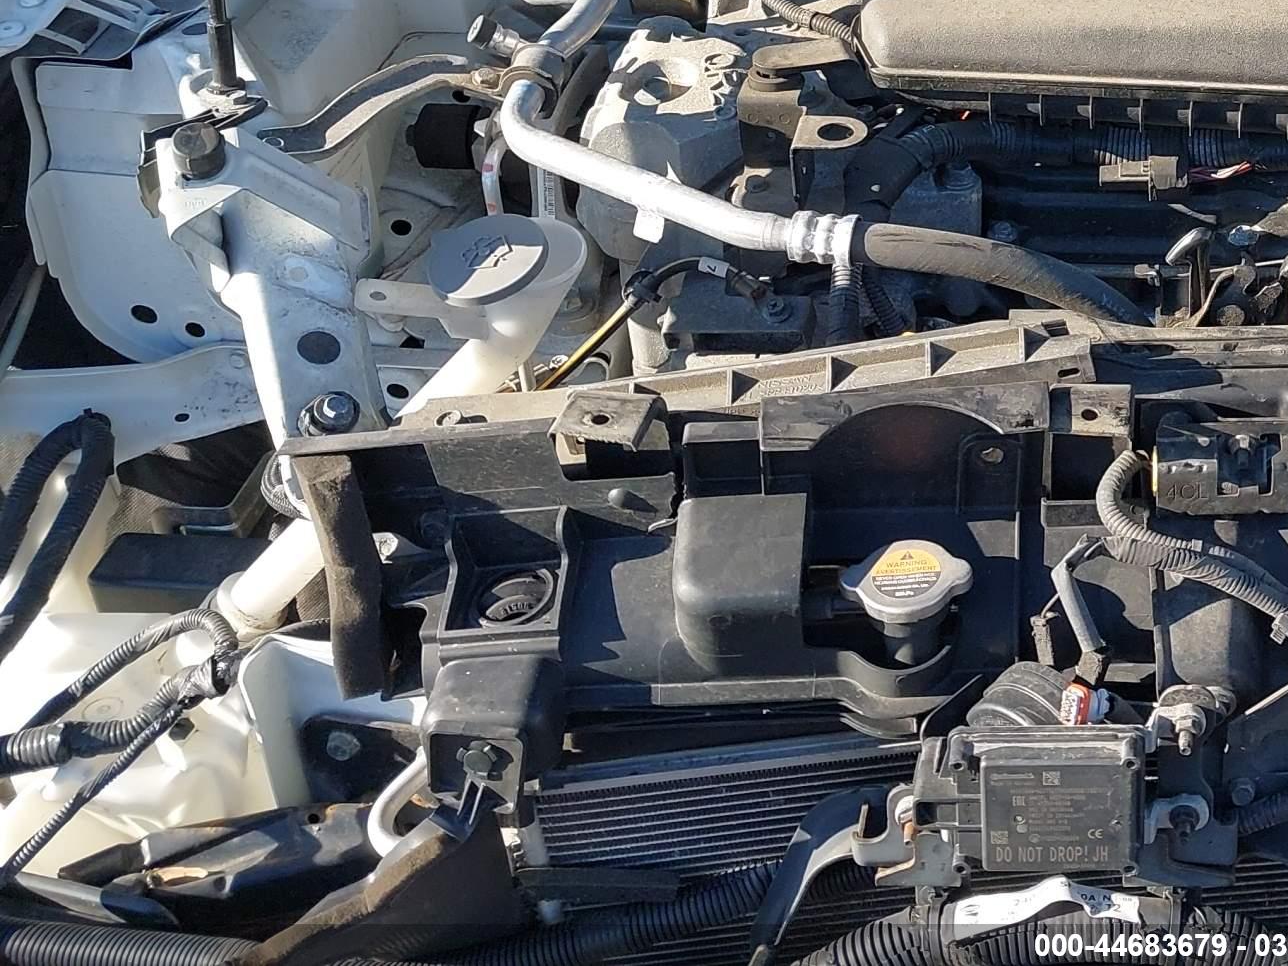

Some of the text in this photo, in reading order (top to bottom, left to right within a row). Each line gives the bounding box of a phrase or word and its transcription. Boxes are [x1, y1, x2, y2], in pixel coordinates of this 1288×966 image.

[886, 559, 928, 568] WARNING
[995, 845, 1109, 862] DO NOT DROP! JH
